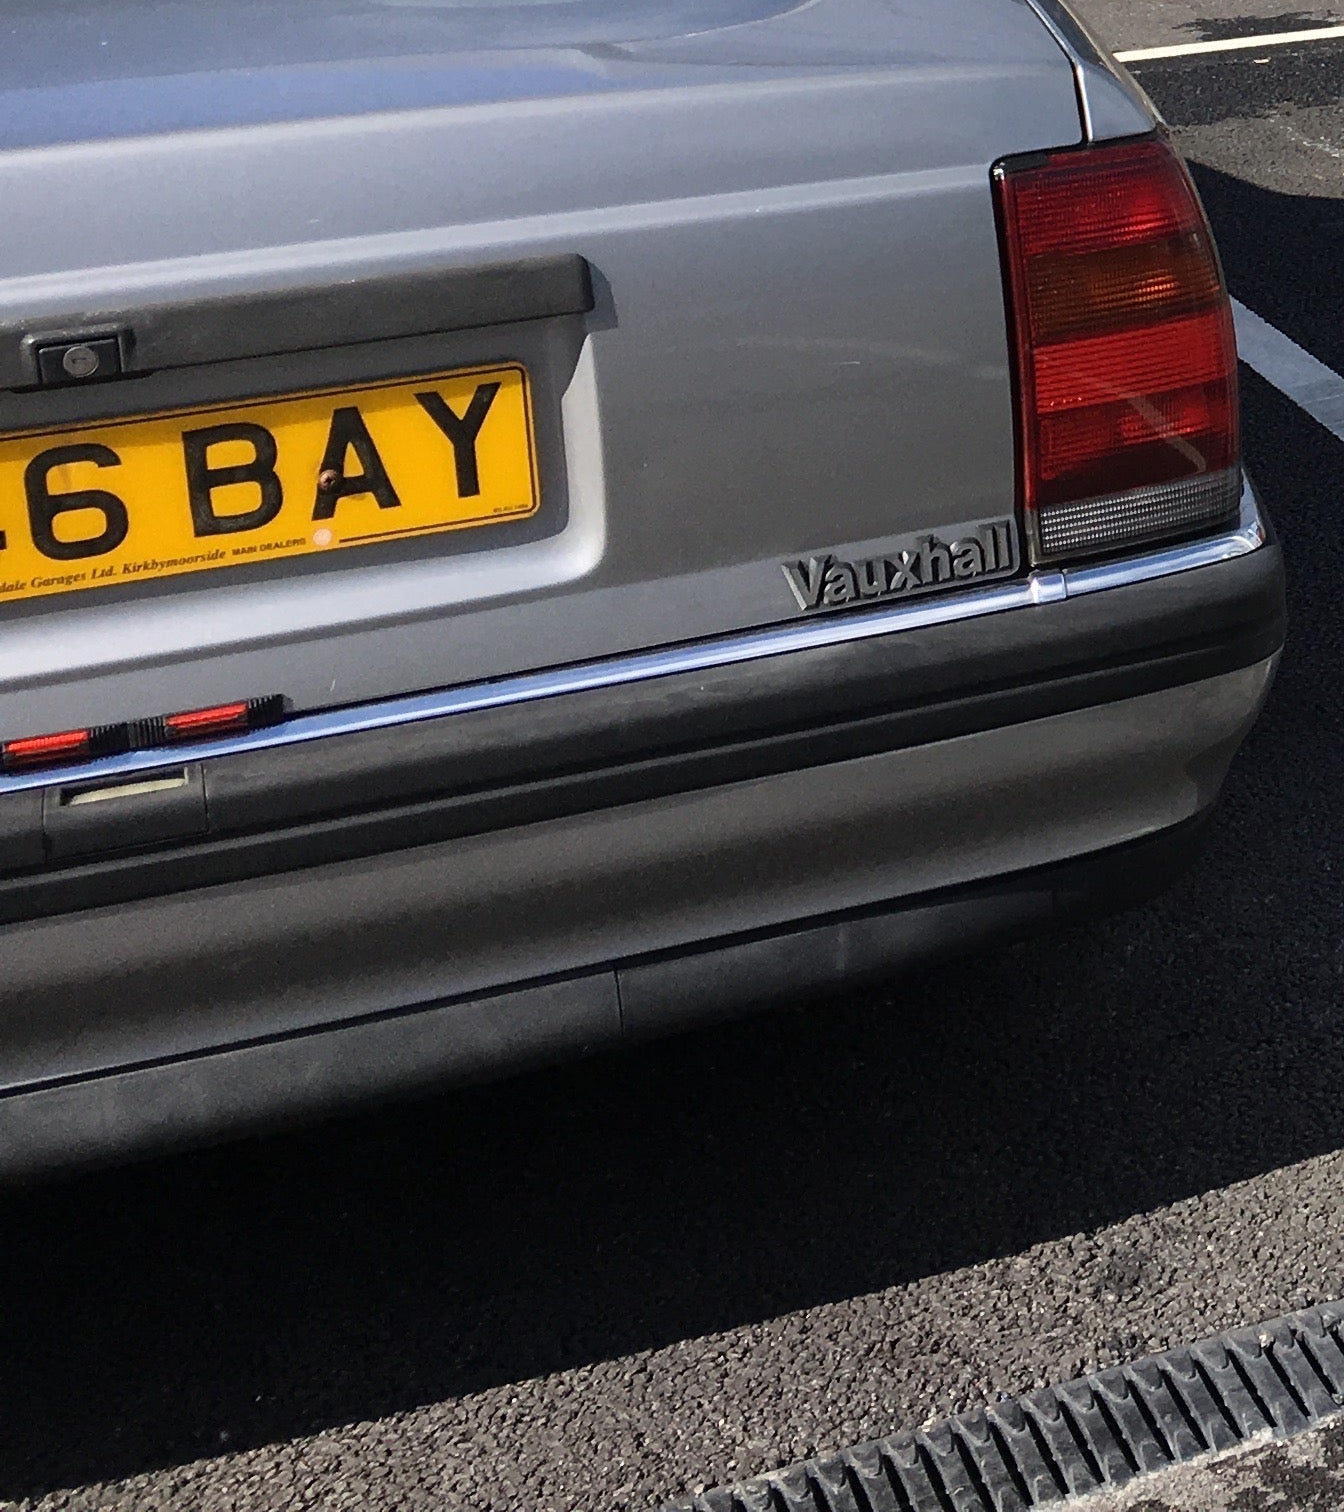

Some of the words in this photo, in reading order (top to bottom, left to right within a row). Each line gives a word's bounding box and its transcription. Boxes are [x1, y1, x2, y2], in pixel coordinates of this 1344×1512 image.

[0, 442, 130, 562] 6
[181, 381, 503, 538] BAY
[31, 572, 87, 589] Garages
[91, 565, 117, 580] Ltd.
[122, 548, 227, 576] Kirkbymoorside
[231, 545, 258, 557] MAIN
[259, 538, 307, 553] DEALERS
[780, 518, 1011, 611] Vauxhall
